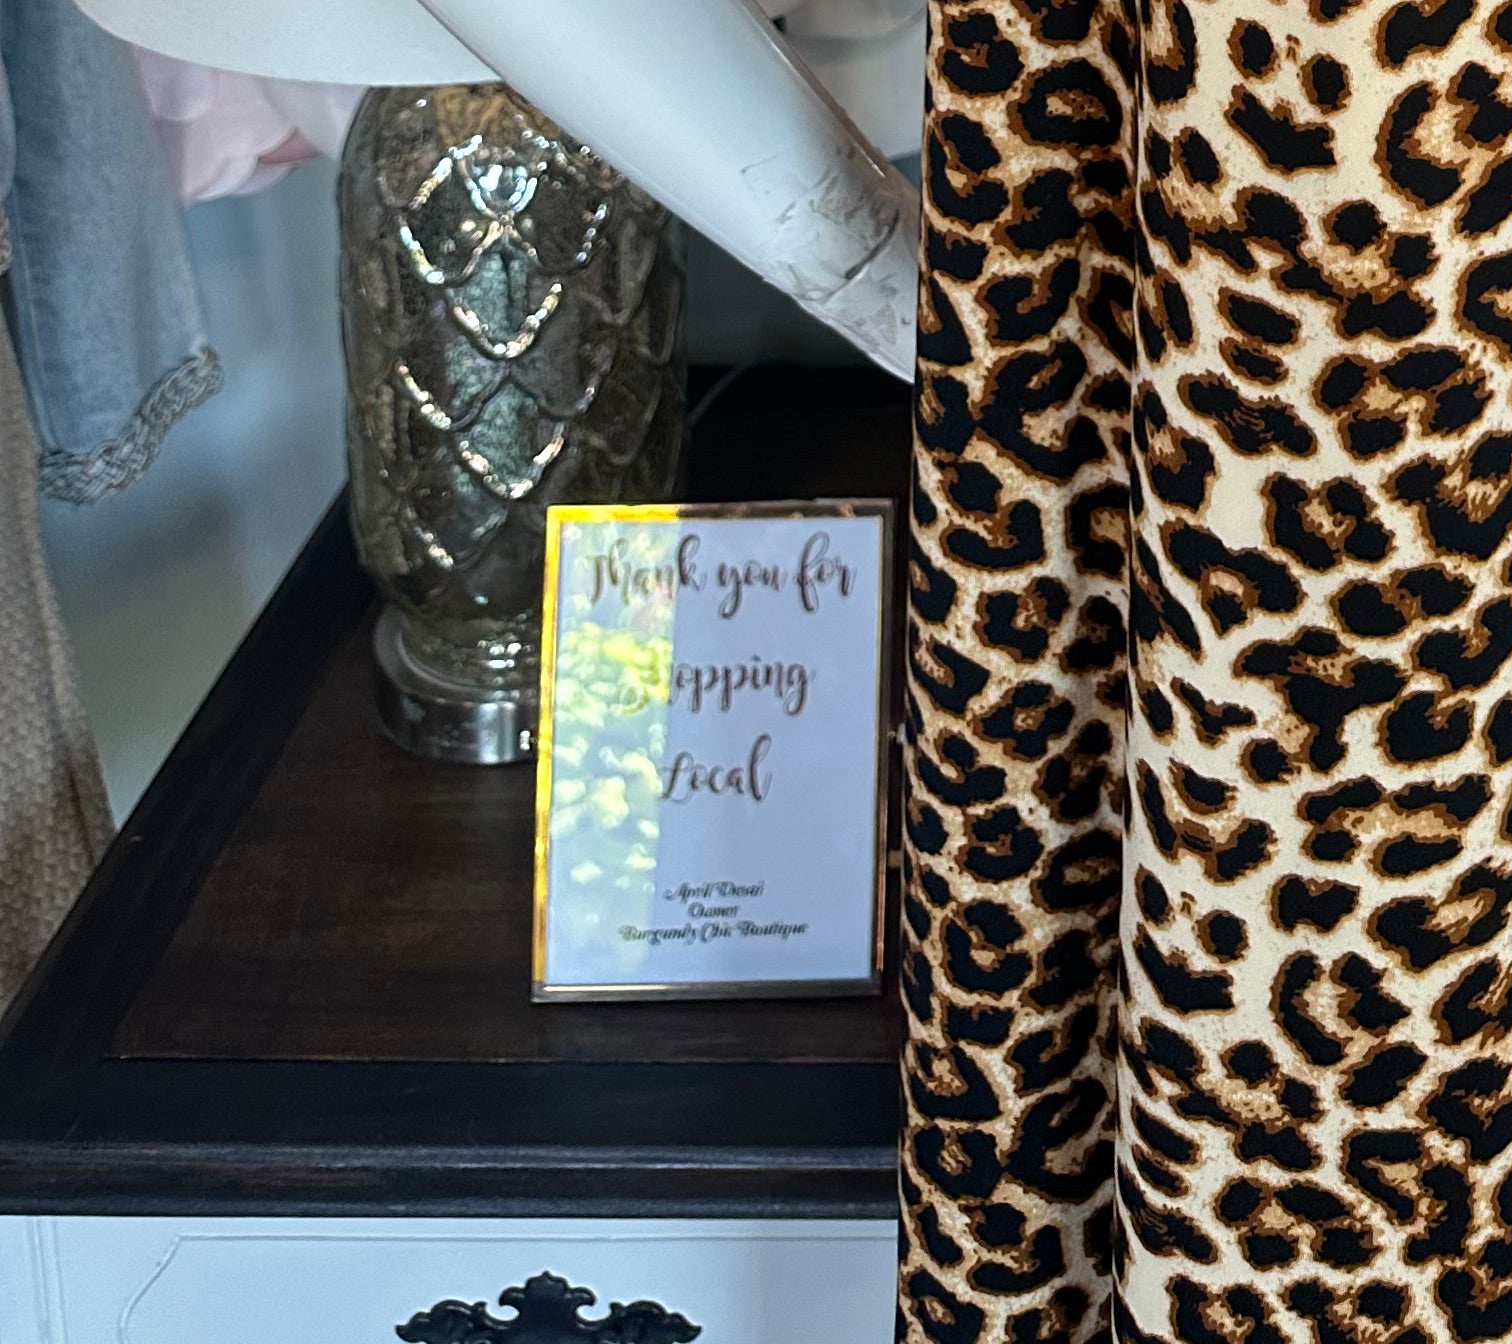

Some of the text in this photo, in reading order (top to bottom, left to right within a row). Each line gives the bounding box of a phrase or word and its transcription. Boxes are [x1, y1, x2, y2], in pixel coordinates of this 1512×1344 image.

[588, 531, 857, 619] Thank you for
[620, 654, 816, 717] opping
[657, 733, 772, 805] Local
[735, 919, 809, 941] Boutique
